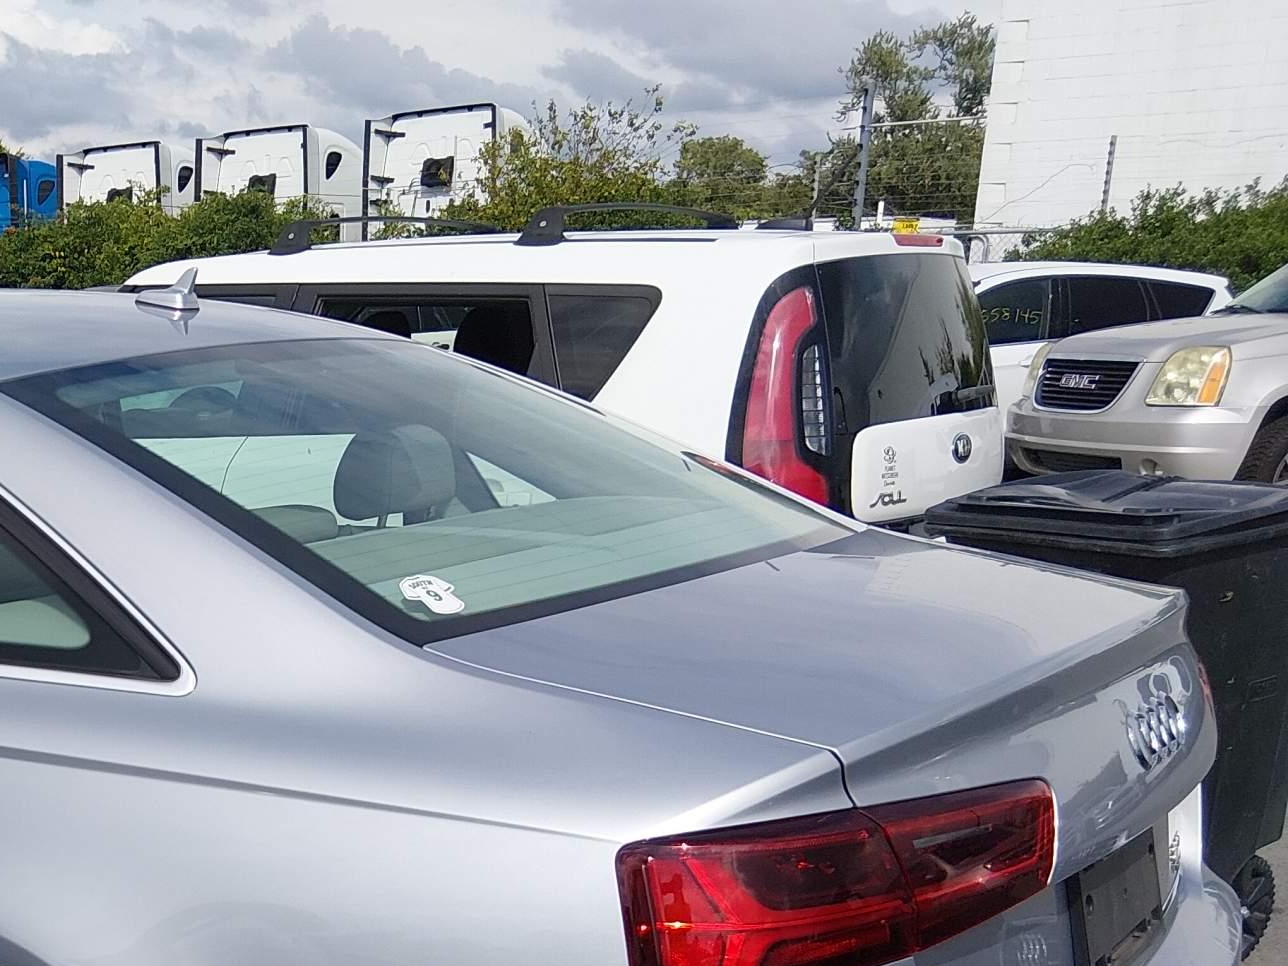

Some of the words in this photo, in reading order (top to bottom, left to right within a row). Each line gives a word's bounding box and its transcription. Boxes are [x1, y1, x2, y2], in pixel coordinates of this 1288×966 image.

[1015, 309, 1042, 324] 145
[1060, 373, 1100, 389] GMC
[869, 490, 908, 508] SOUL
